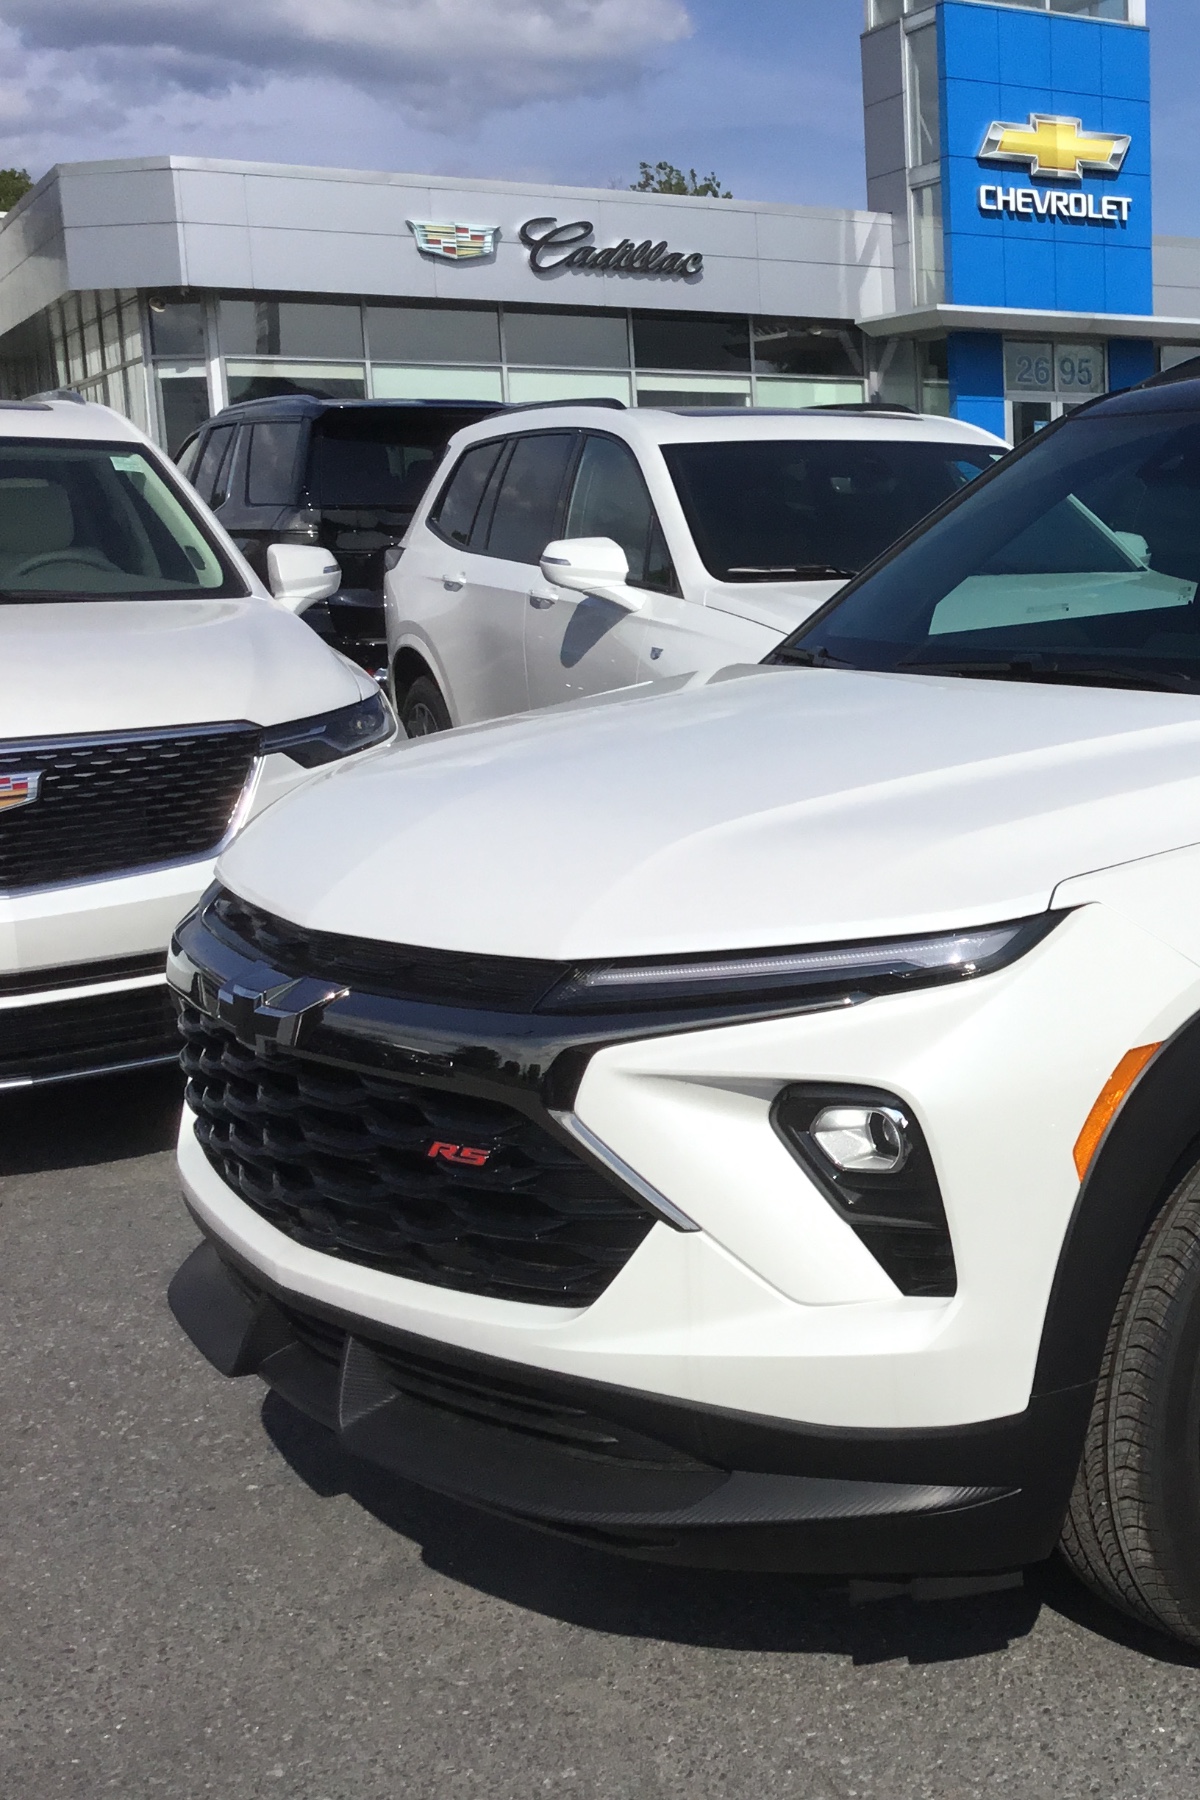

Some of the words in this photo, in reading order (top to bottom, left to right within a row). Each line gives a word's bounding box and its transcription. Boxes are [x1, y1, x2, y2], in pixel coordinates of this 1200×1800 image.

[979, 184, 1133, 221] CHEVROLET
[519, 216, 703, 278] Cadillac
[427, 1140, 491, 1167] RS
